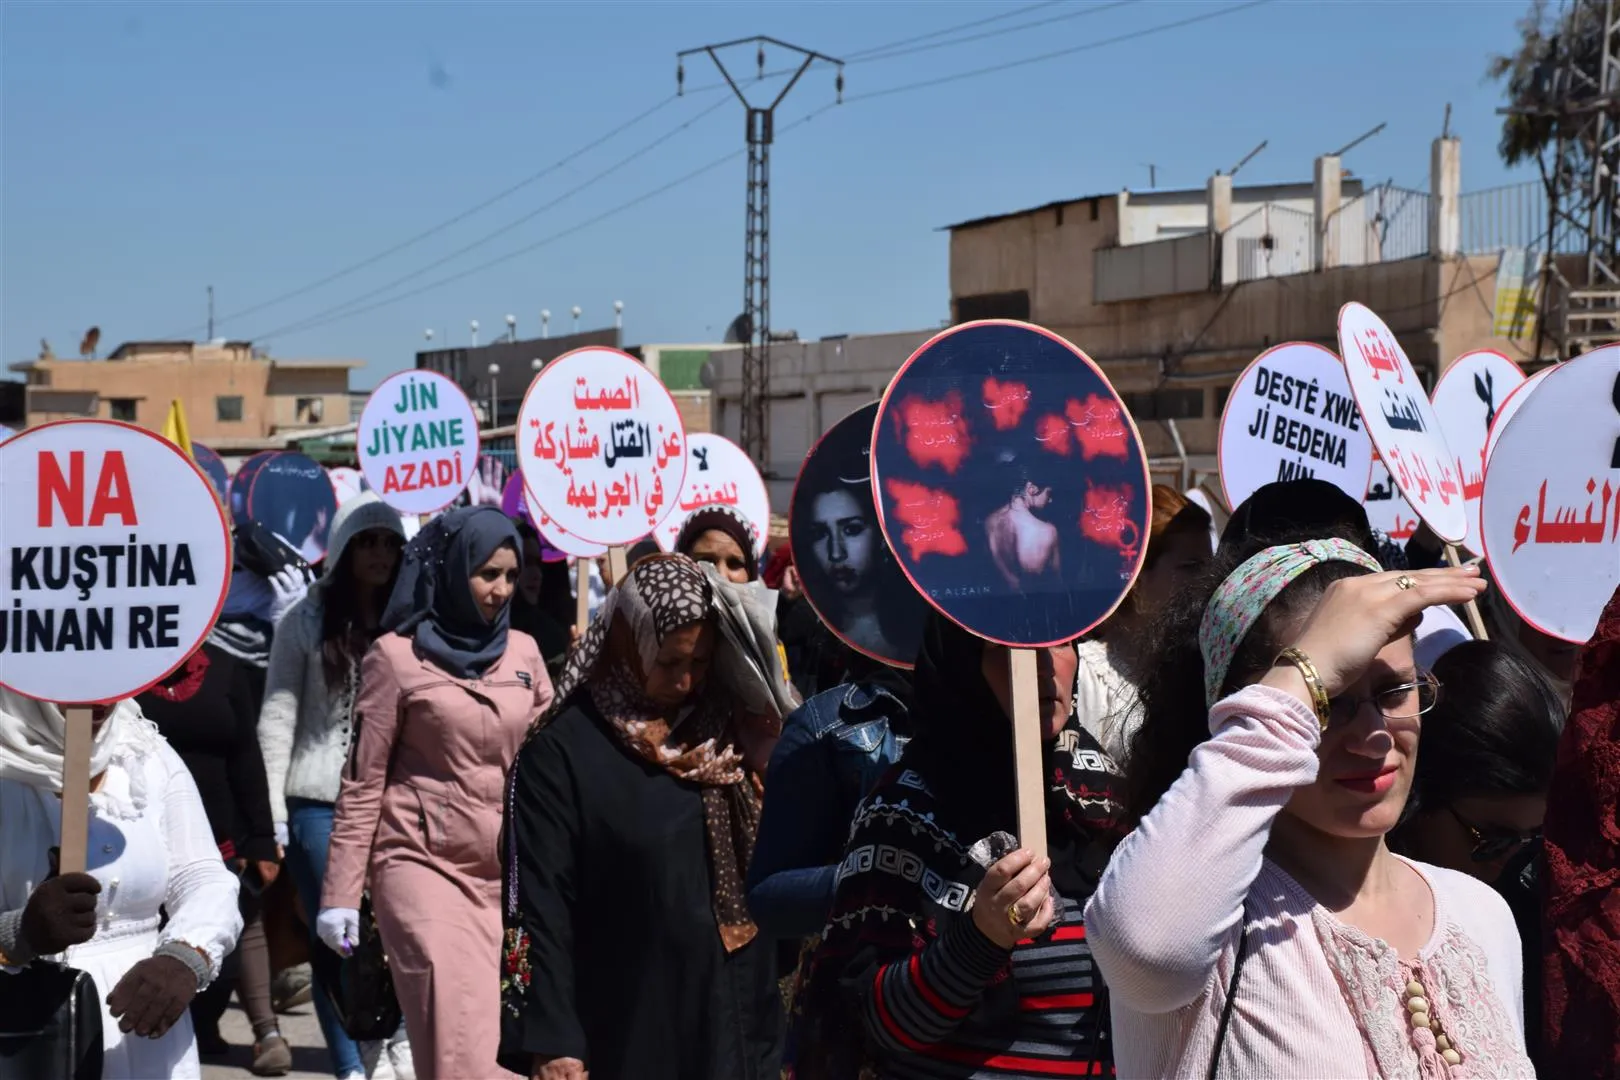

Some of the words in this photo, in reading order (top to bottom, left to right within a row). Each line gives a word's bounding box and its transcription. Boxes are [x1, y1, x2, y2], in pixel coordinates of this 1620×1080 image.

[573, 374, 640, 411] الصمت
[1254, 366, 1319, 415] DESTÊ
[1379, 386, 1428, 433] العنف
[529, 415, 600, 470] مشاركة
[603, 418, 651, 469] القتل
[657, 424, 682, 469] عن
[692, 446, 709, 471] لا
[1272, 414, 1347, 469] BEDENA
[37, 451, 138, 527] NA
[383, 453, 462, 493] AZADÎ
[562, 466, 640, 519] الجريمة
[643, 466, 664, 526] في
[129, 605, 179, 648] RE
